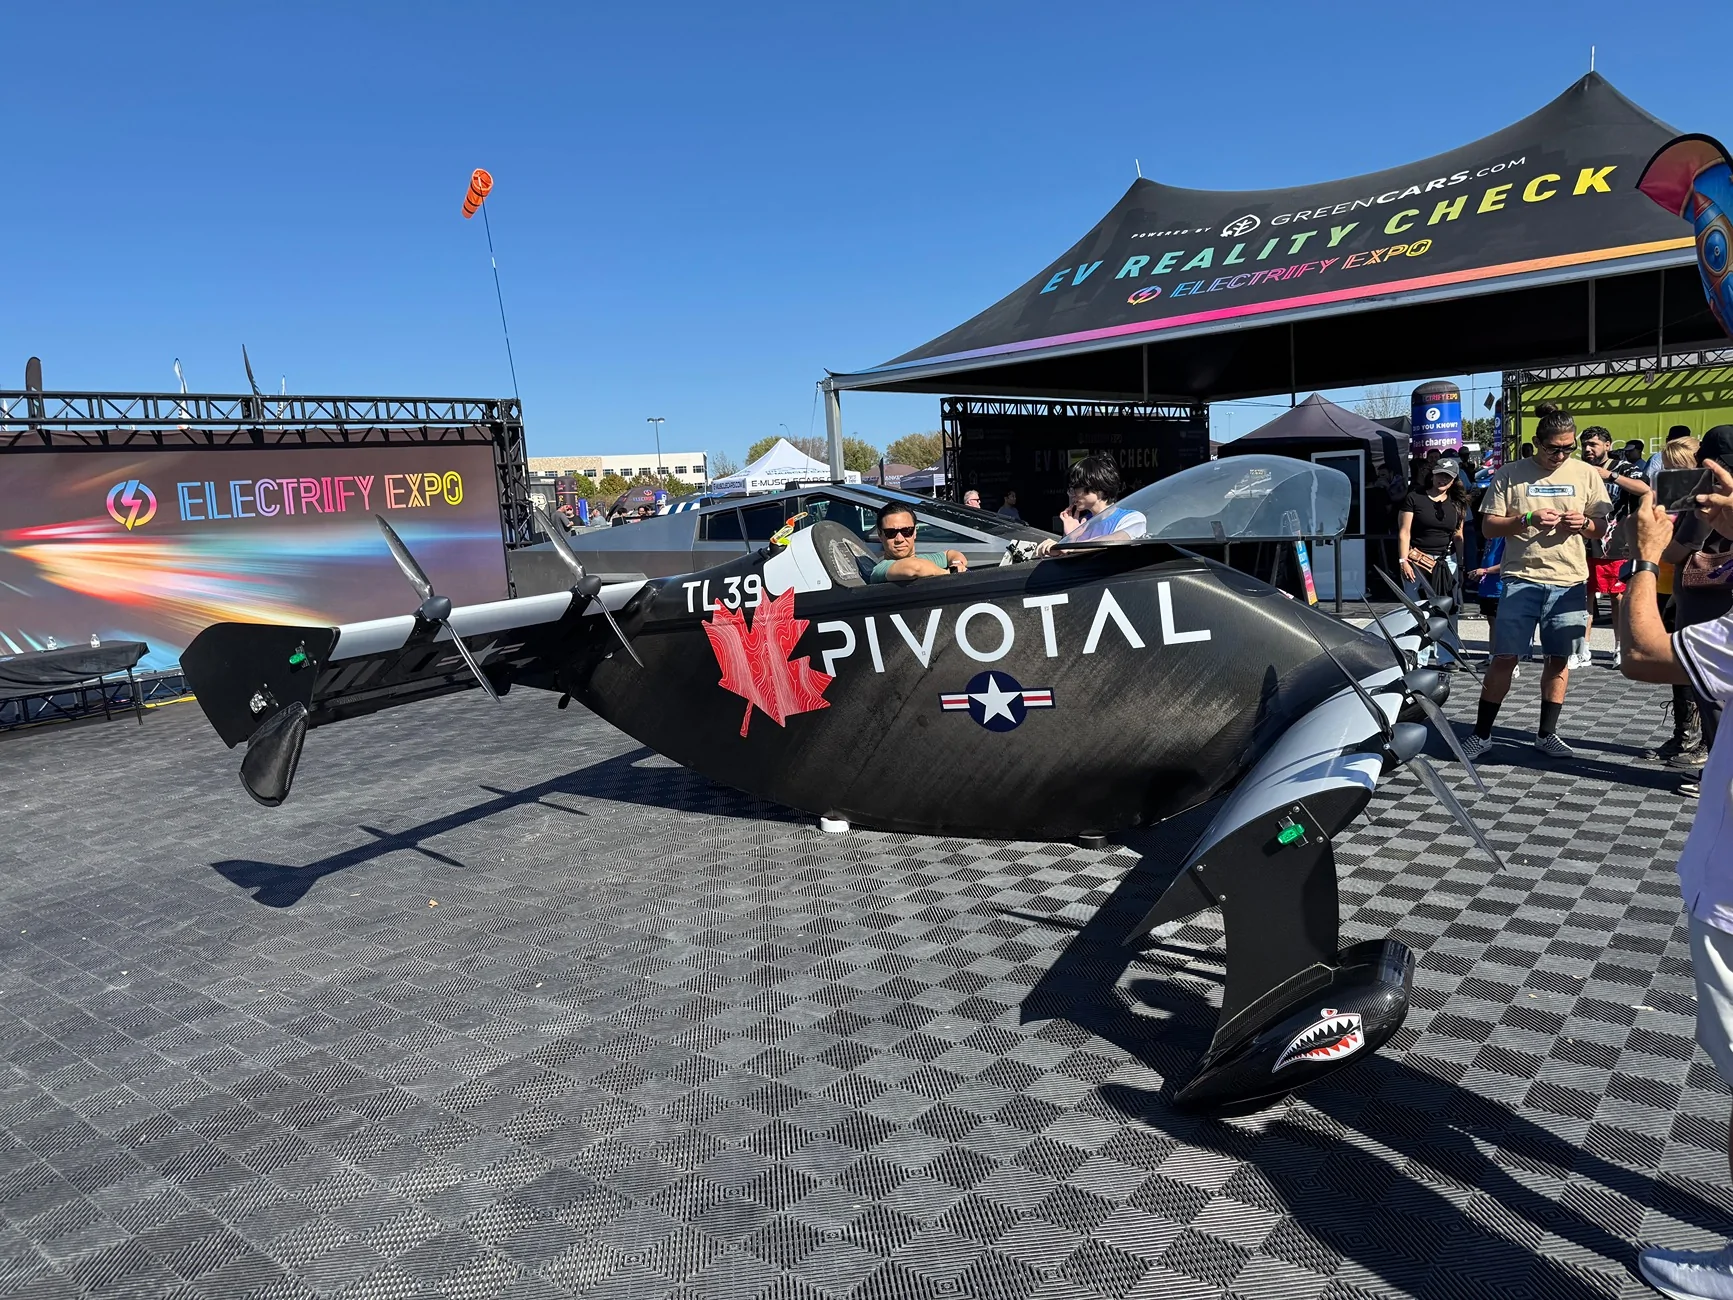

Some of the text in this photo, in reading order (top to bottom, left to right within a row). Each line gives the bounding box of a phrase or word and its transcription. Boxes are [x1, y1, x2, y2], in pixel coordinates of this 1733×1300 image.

[1131, 229, 1189, 239] POWERED
[1270, 156, 1526, 226] GREENCARS.COM
[1039, 165, 1618, 295] EV REALITY CHECK
[1169, 239, 1433, 298] ELECTRIFY EXPO
[1120, 448, 1159, 468] CHECK
[1425, 437, 1457, 447] chargers
[176, 470, 463, 522] ELECTRIFY EXPO
[682, 573, 763, 613] TL39
[817, 581, 1211, 678] PIVOTAL
